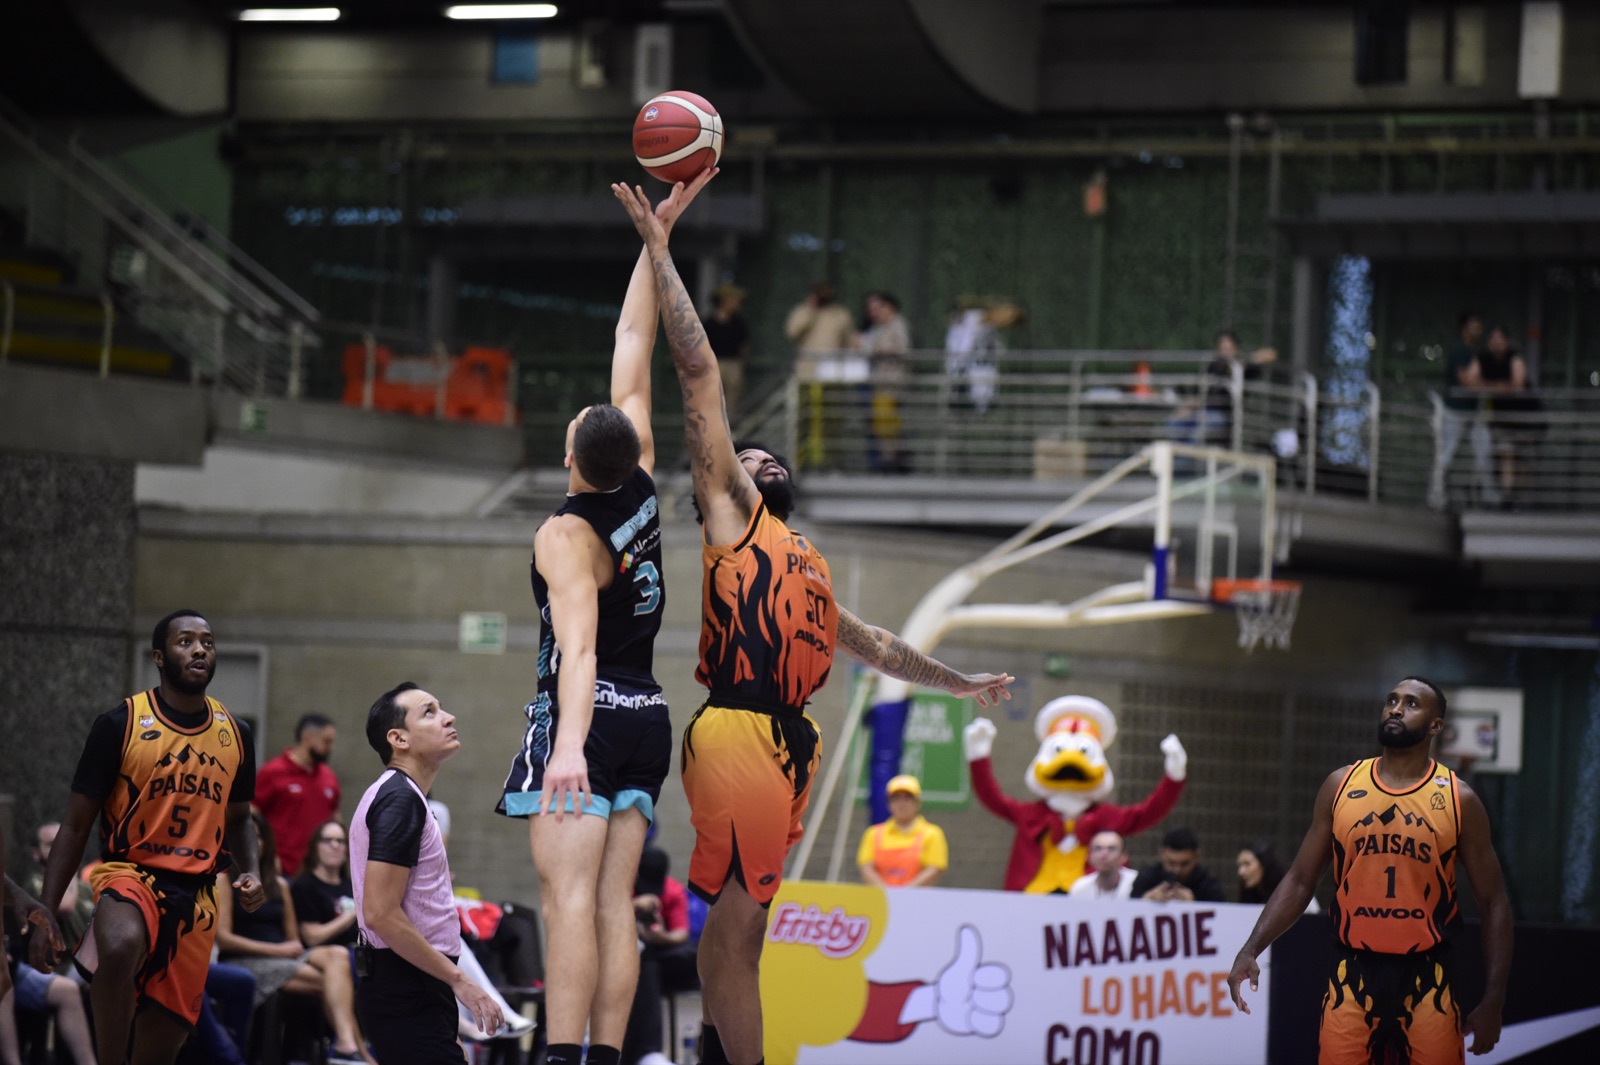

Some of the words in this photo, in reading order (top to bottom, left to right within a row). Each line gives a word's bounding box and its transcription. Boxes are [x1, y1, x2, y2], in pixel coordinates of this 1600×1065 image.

[633, 560, 660, 616] 3
[147, 772, 223, 805] PAISAS
[168, 804, 190, 838] 5
[136, 841, 210, 861] AWOO
[1354, 833, 1432, 864] PAISAS
[1384, 866, 1396, 898] 1
[770, 905, 868, 953] Frisby
[1353, 906, 1425, 920] AWOO
[1044, 911, 1218, 969] NAAADIE
[1082, 975, 1122, 1017] LO
[1131, 970, 1233, 1021] HACE
[1046, 1023, 1161, 1065] COMO
